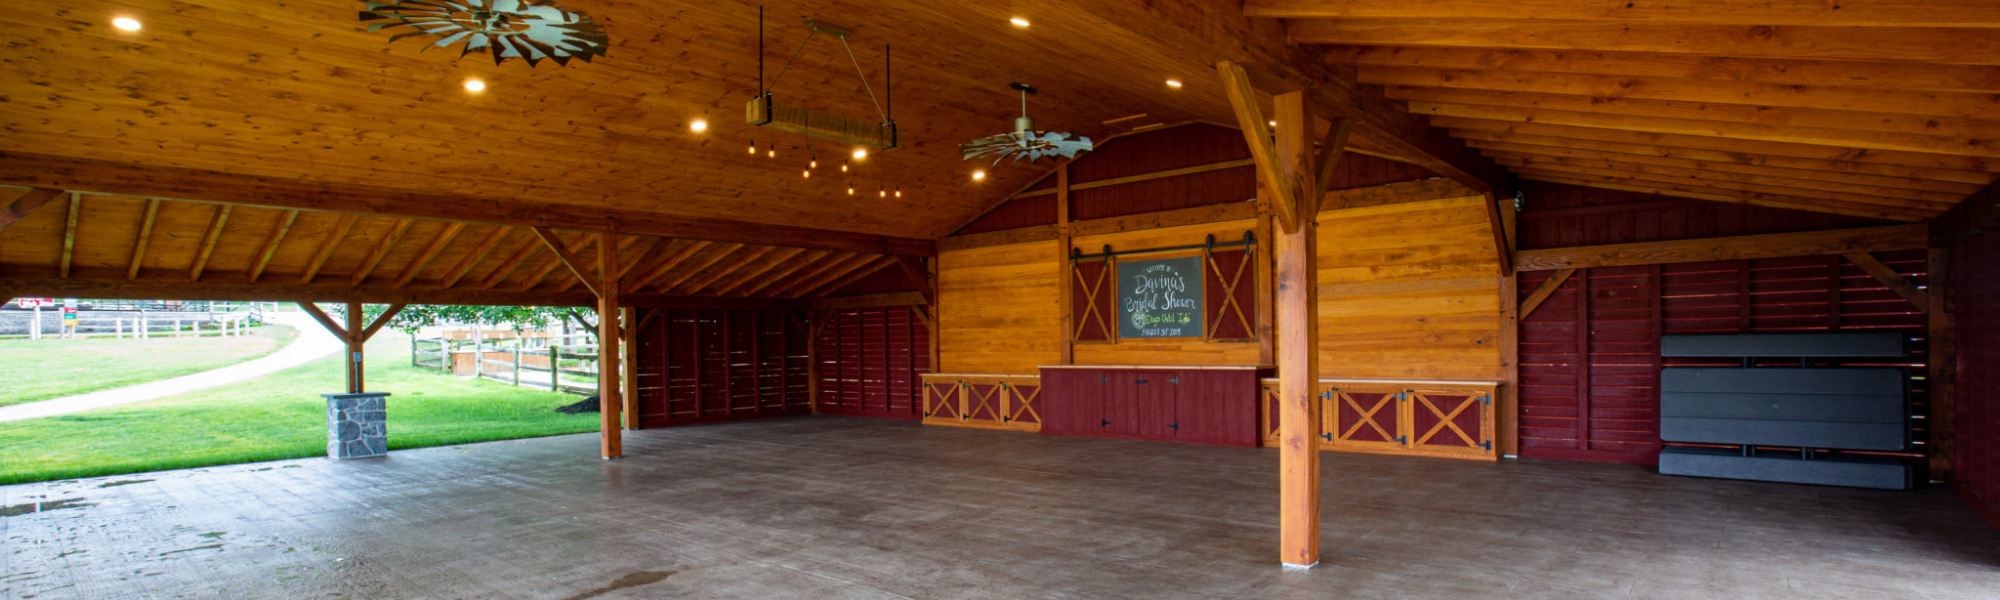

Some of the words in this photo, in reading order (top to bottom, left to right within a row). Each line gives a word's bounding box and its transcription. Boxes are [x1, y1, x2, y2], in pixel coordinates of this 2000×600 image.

[1133, 272, 1185, 294] Davina's
[1124, 292, 1158, 312] Bridal
[1162, 291, 1196, 310] Shower
[1146, 314, 1160, 328] Days
[1161, 312, 1175, 323] Until
